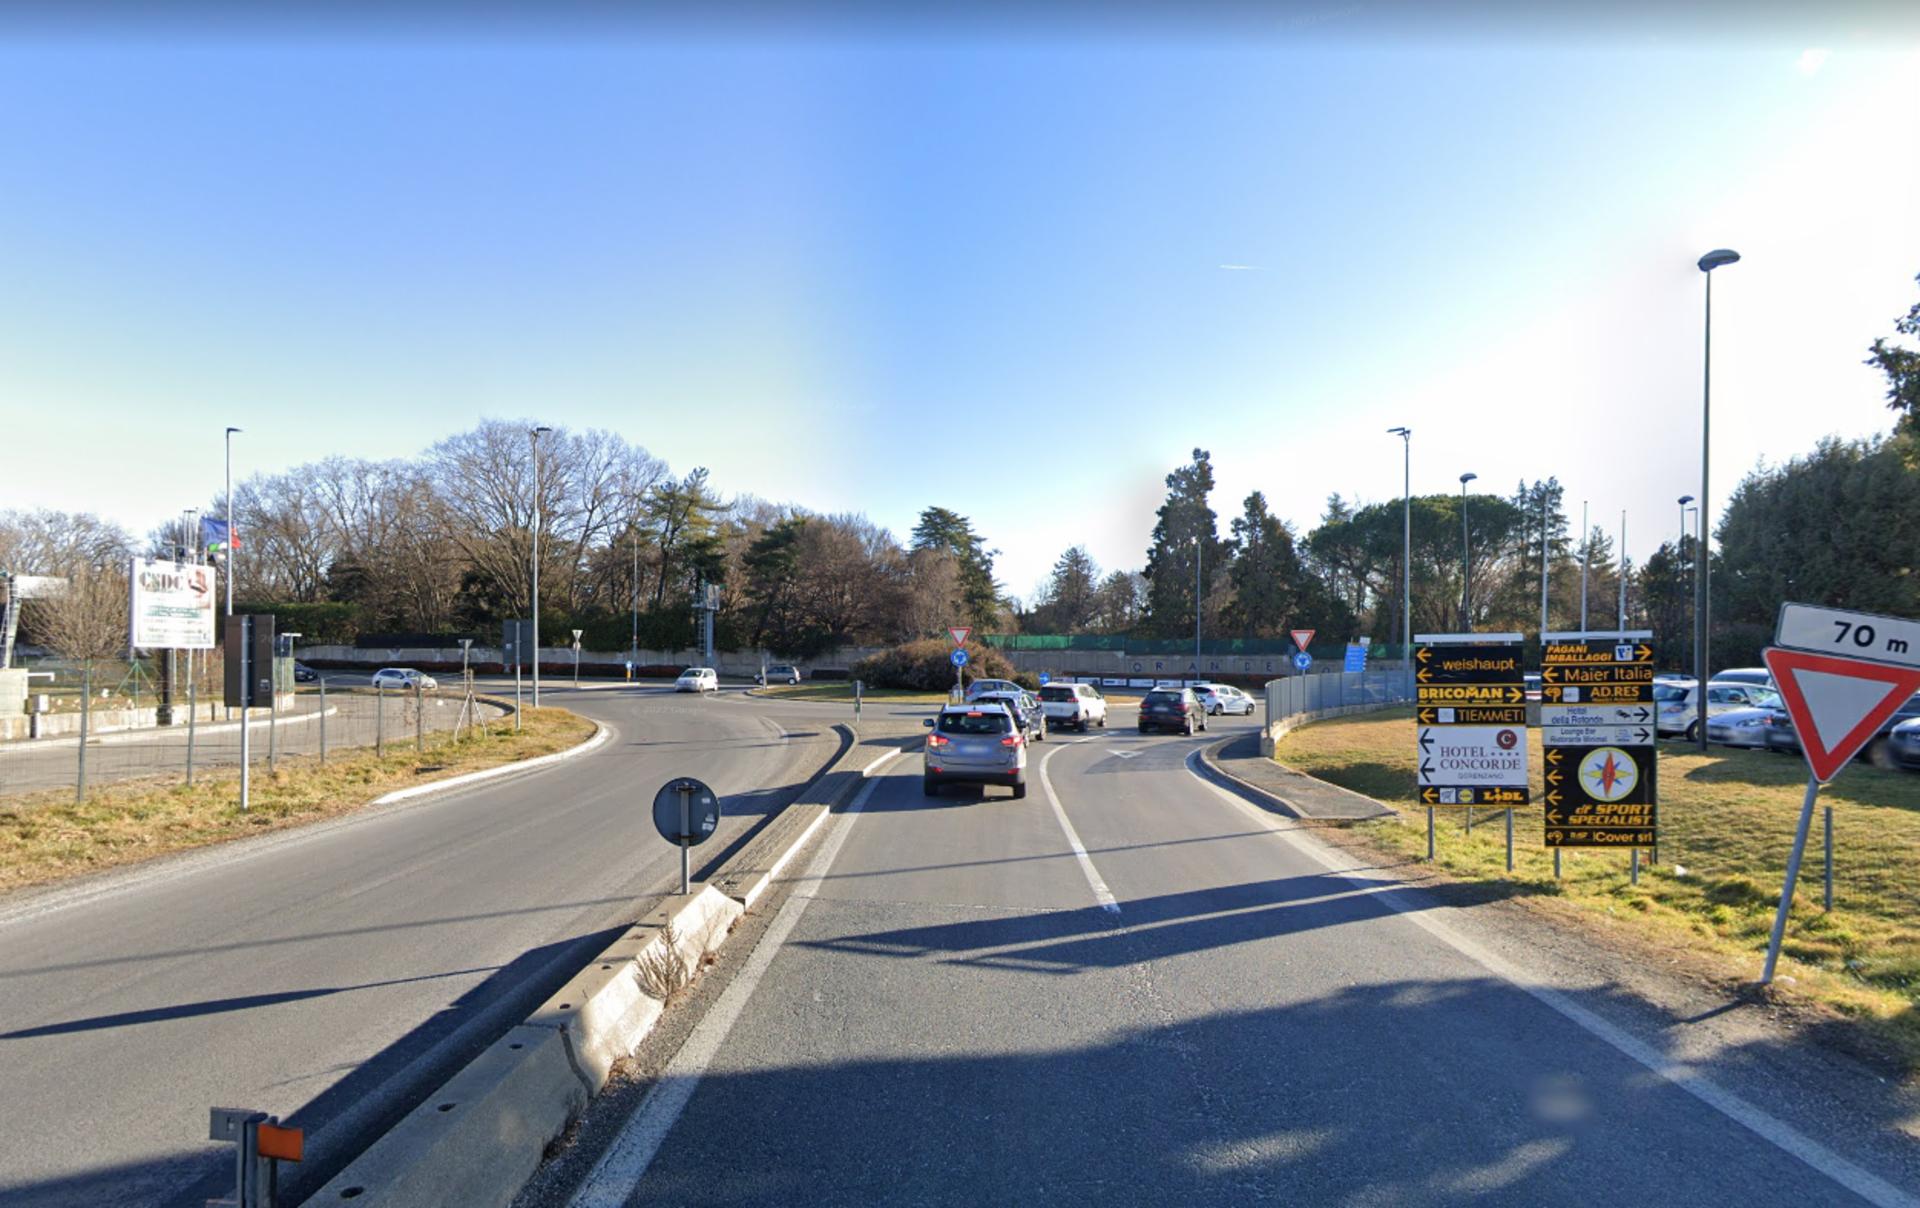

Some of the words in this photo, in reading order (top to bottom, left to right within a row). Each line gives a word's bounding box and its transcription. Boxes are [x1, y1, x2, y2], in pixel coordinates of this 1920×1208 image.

[1834, 620, 1875, 648] 70
[1886, 638, 1908, 654] m
[1547, 645, 1588, 654] PAGANI
[1545, 653, 1612, 662] IMBALLAGGI
[1564, 668, 1610, 682] Maier
[1614, 666, 1653, 680] Italia
[1418, 686, 1504, 699] BRICOMAN
[1590, 686, 1640, 697] AD.RES
[1458, 709, 1524, 722] TIEMMETI
[1440, 746, 1487, 758] HOTEL
[1440, 758, 1521, 770] CONCORDE
[1595, 804, 1653, 815] SPORT
[1568, 815, 1652, 825] SPECIALIST
